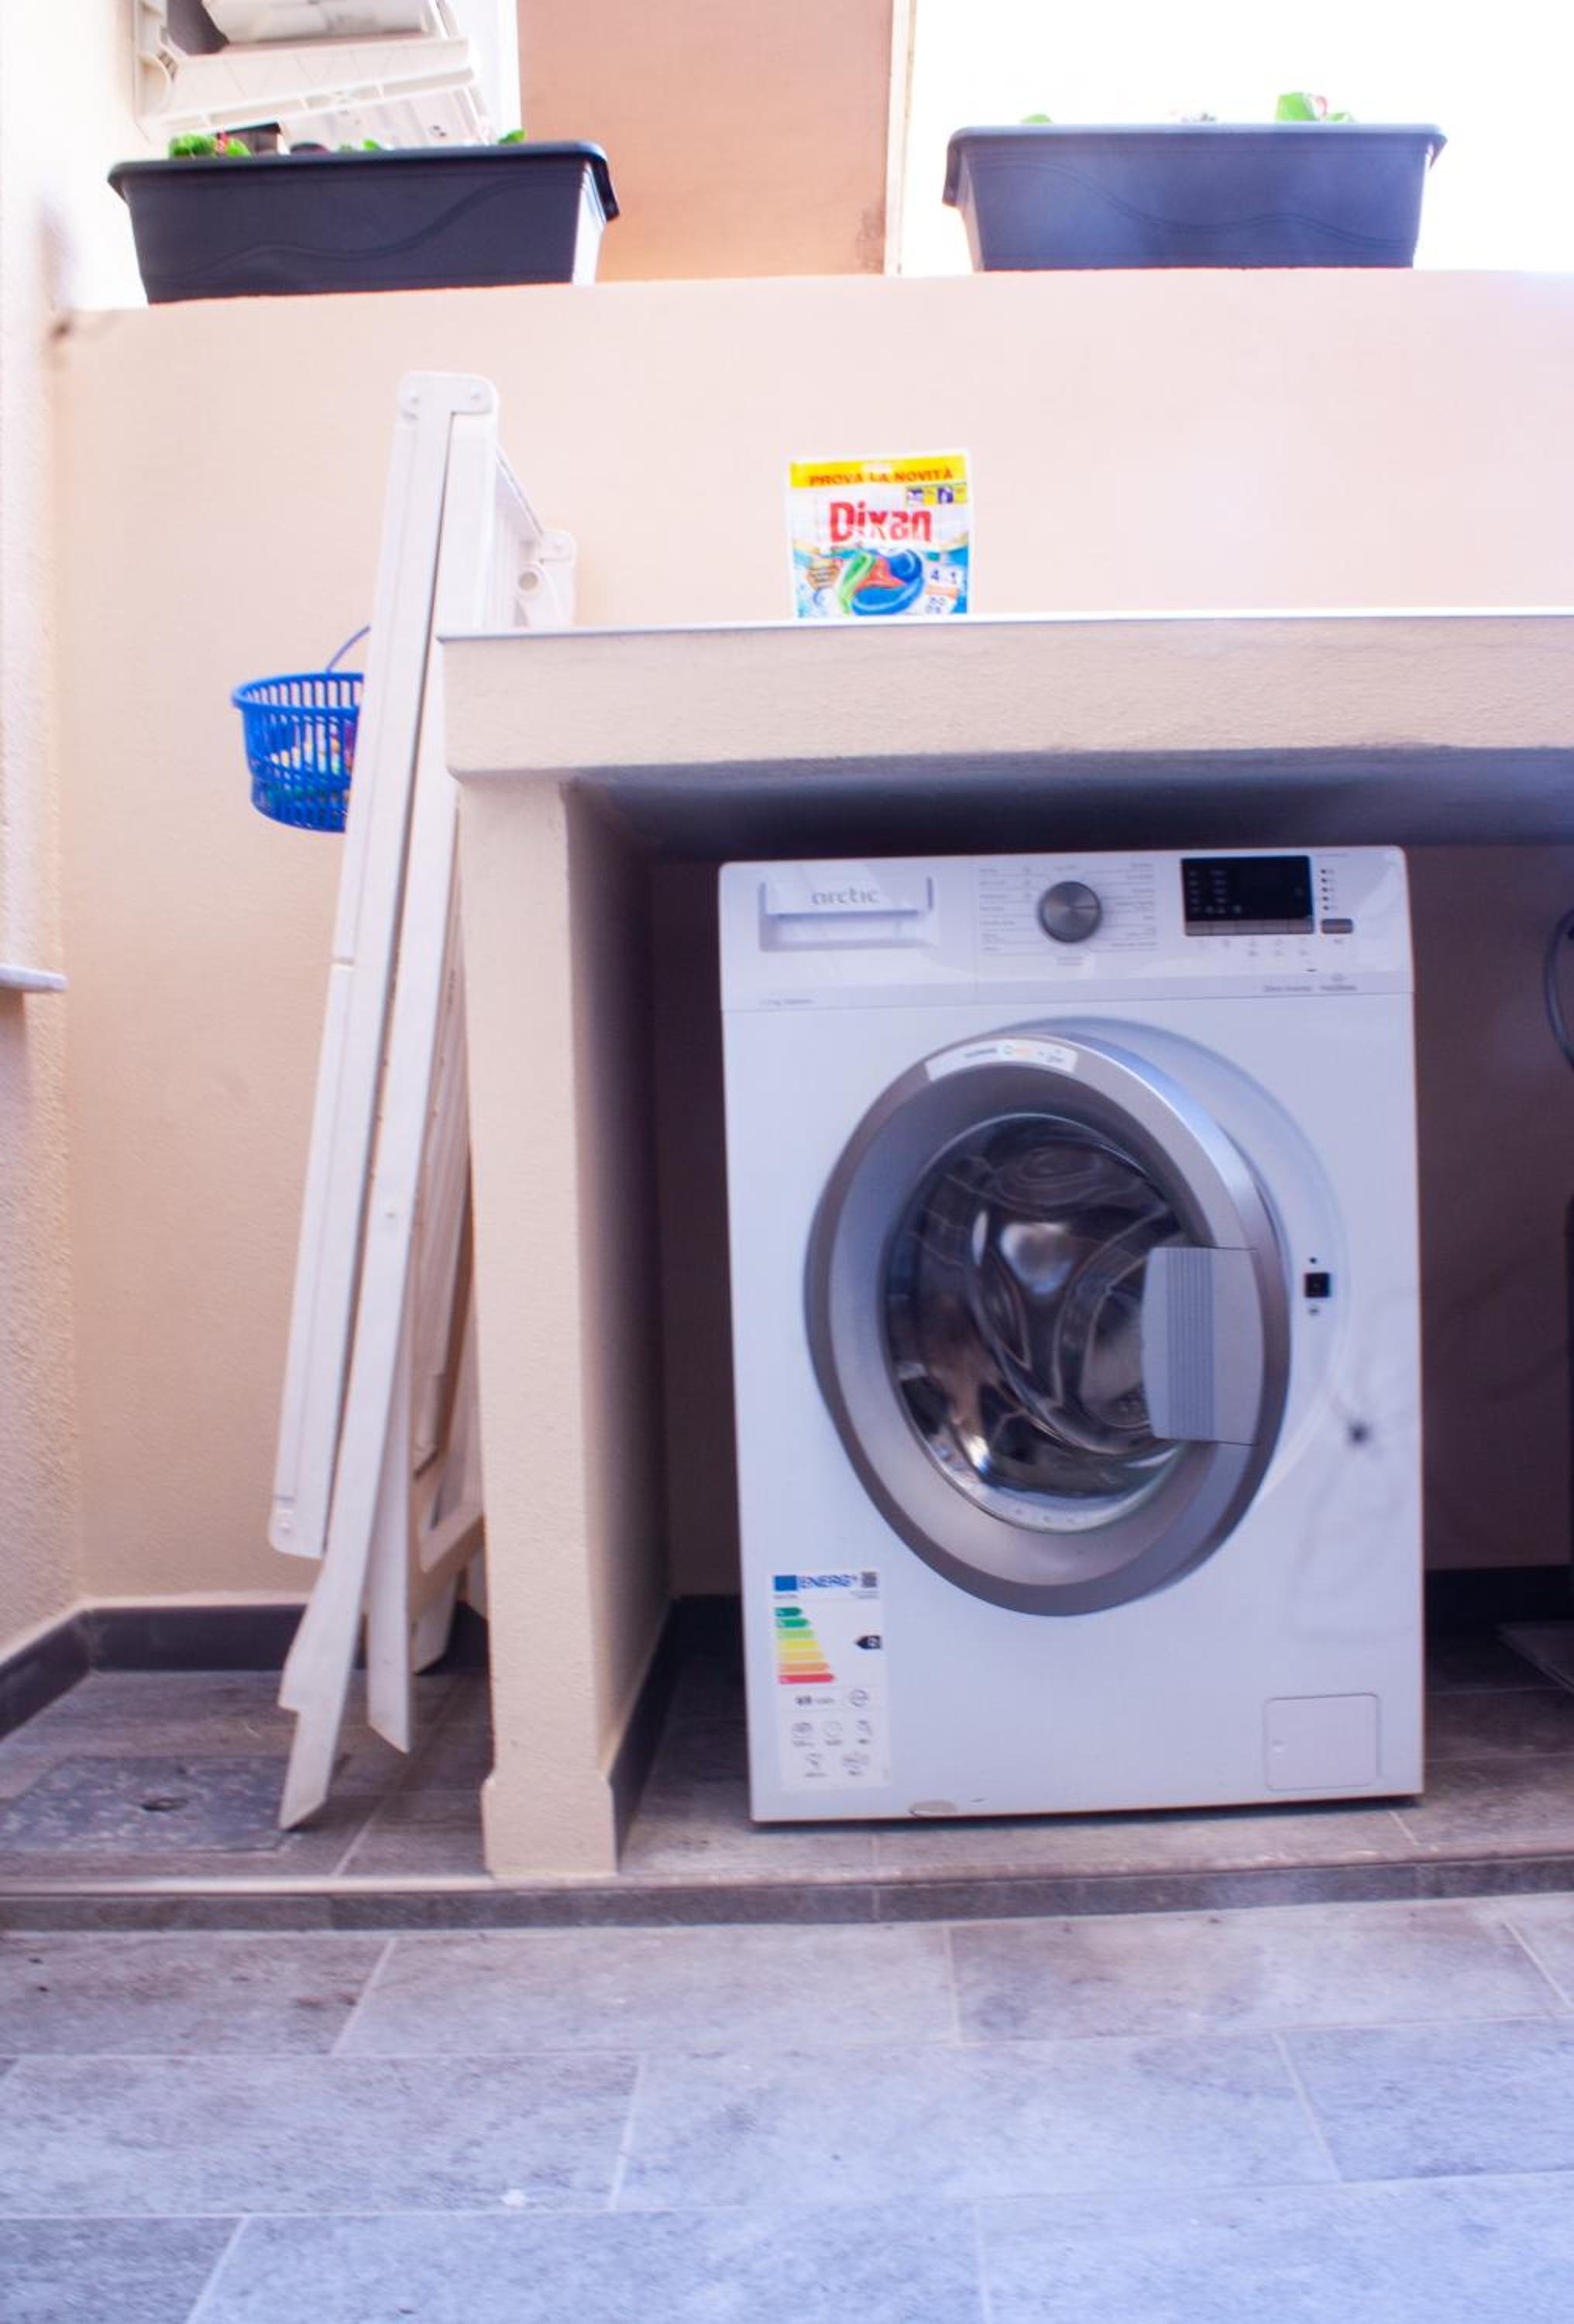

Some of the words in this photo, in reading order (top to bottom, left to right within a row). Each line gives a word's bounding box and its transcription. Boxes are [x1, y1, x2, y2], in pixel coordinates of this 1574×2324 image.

[809, 472, 864, 486] PROVA
[869, 471, 889, 483] LA
[829, 500, 932, 542] Dixan
[811, 887, 880, 905] arctic
